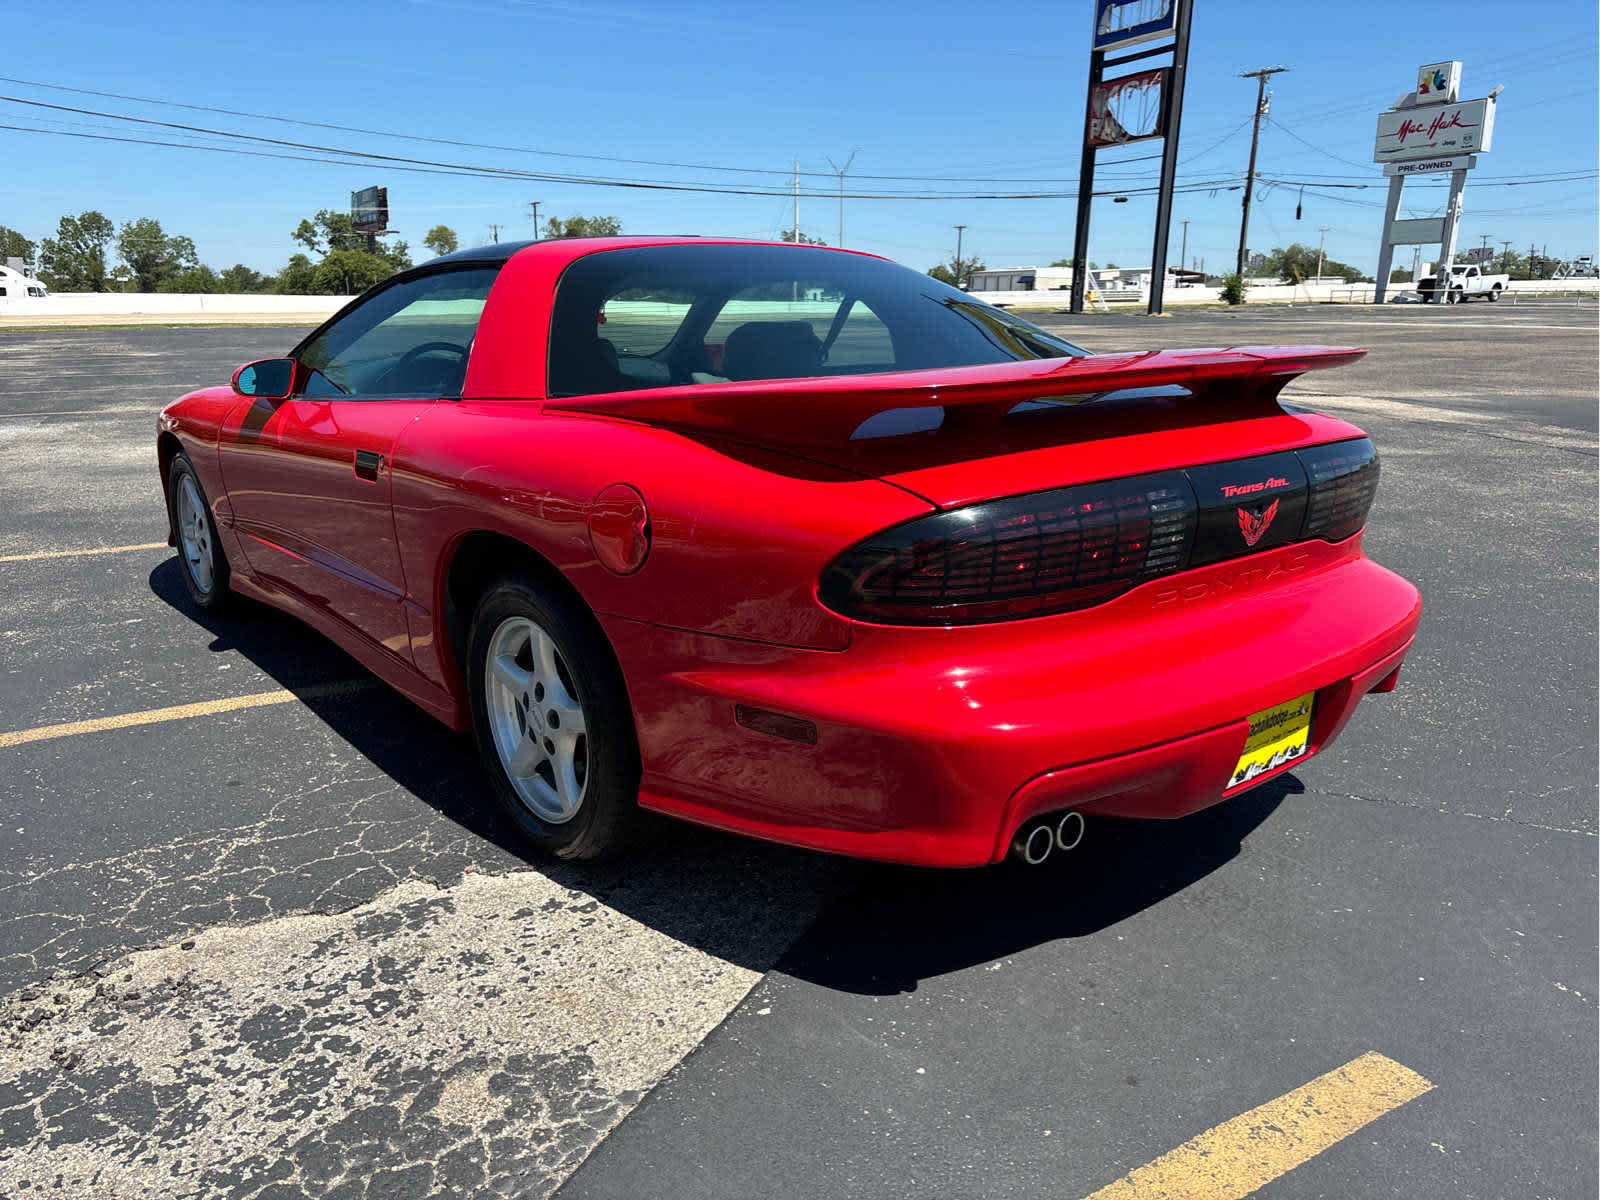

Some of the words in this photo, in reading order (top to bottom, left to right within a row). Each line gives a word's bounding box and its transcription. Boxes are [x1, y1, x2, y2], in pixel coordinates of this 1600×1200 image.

[1391, 119, 1427, 143] Mac
[1427, 110, 1472, 140] Haik
[1397, 161, 1453, 172] PRE-OWNED
[1220, 483, 1264, 498] Trans
[1152, 552, 1310, 609] PONTIAC
